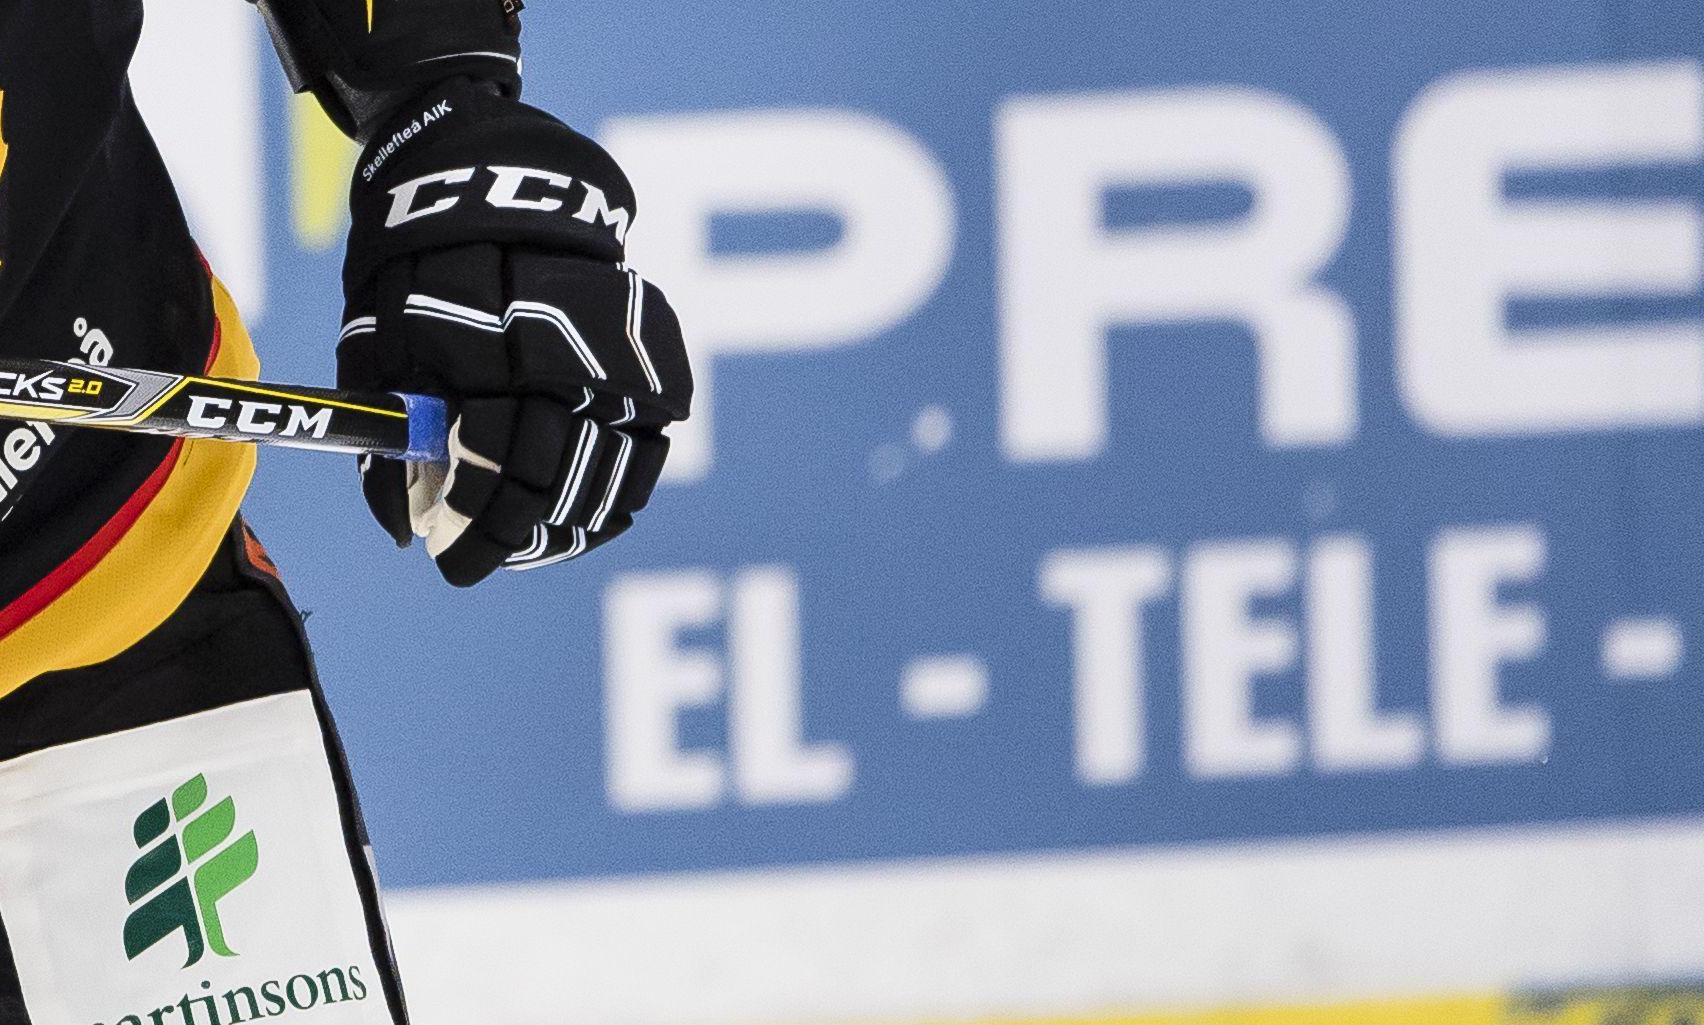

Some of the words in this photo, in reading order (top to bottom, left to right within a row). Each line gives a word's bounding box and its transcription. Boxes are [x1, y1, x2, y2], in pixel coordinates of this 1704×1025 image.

[362, 119, 422, 182] Skellefteå
[423, 99, 453, 126] AIK
[384, 166, 629, 247] CCM
[67, 378, 103, 396] 2.0
[185, 395, 333, 440] CCM
[602, 563, 855, 810] EL
[1038, 523, 1551, 785] TELE
